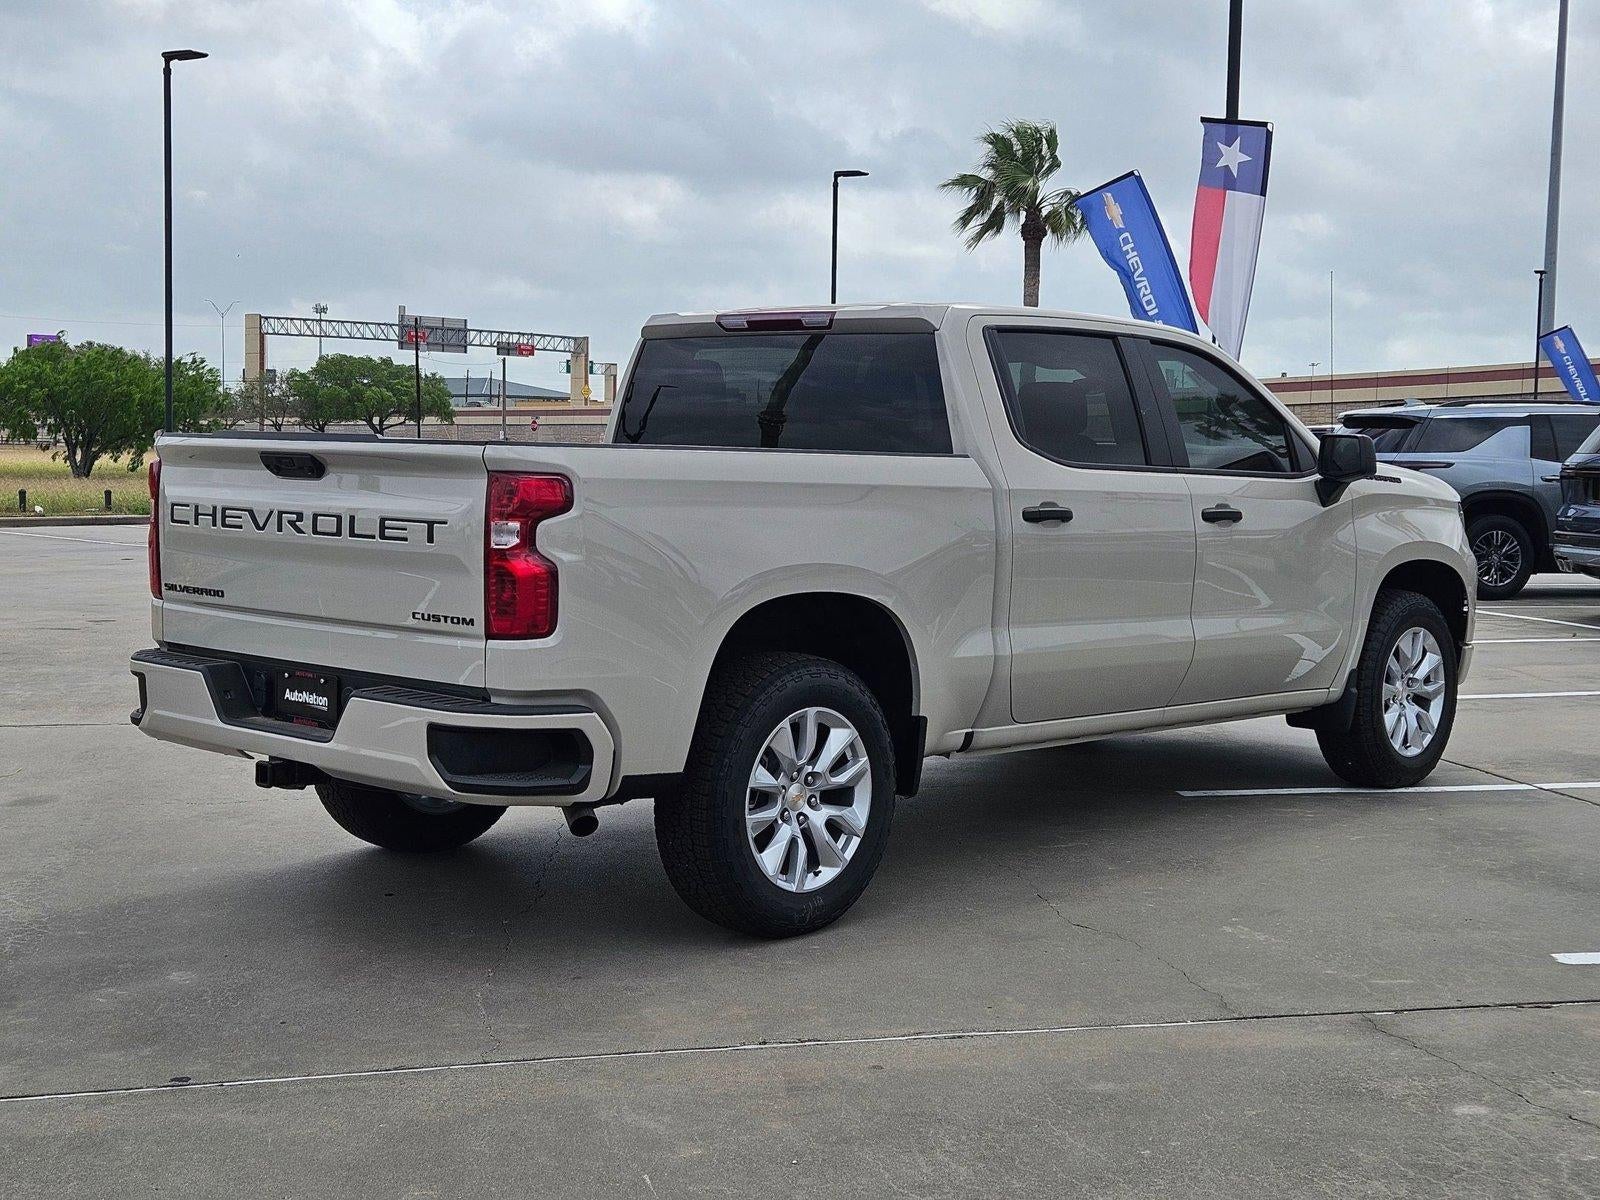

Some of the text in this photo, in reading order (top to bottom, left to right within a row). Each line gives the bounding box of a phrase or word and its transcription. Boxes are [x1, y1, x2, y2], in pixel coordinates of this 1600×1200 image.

[170, 502, 449, 544] CHEVROLET
[164, 582, 225, 598] SILVERADO
[411, 611, 475, 627] CUSTOM
[284, 688, 328, 707] AutoNation
